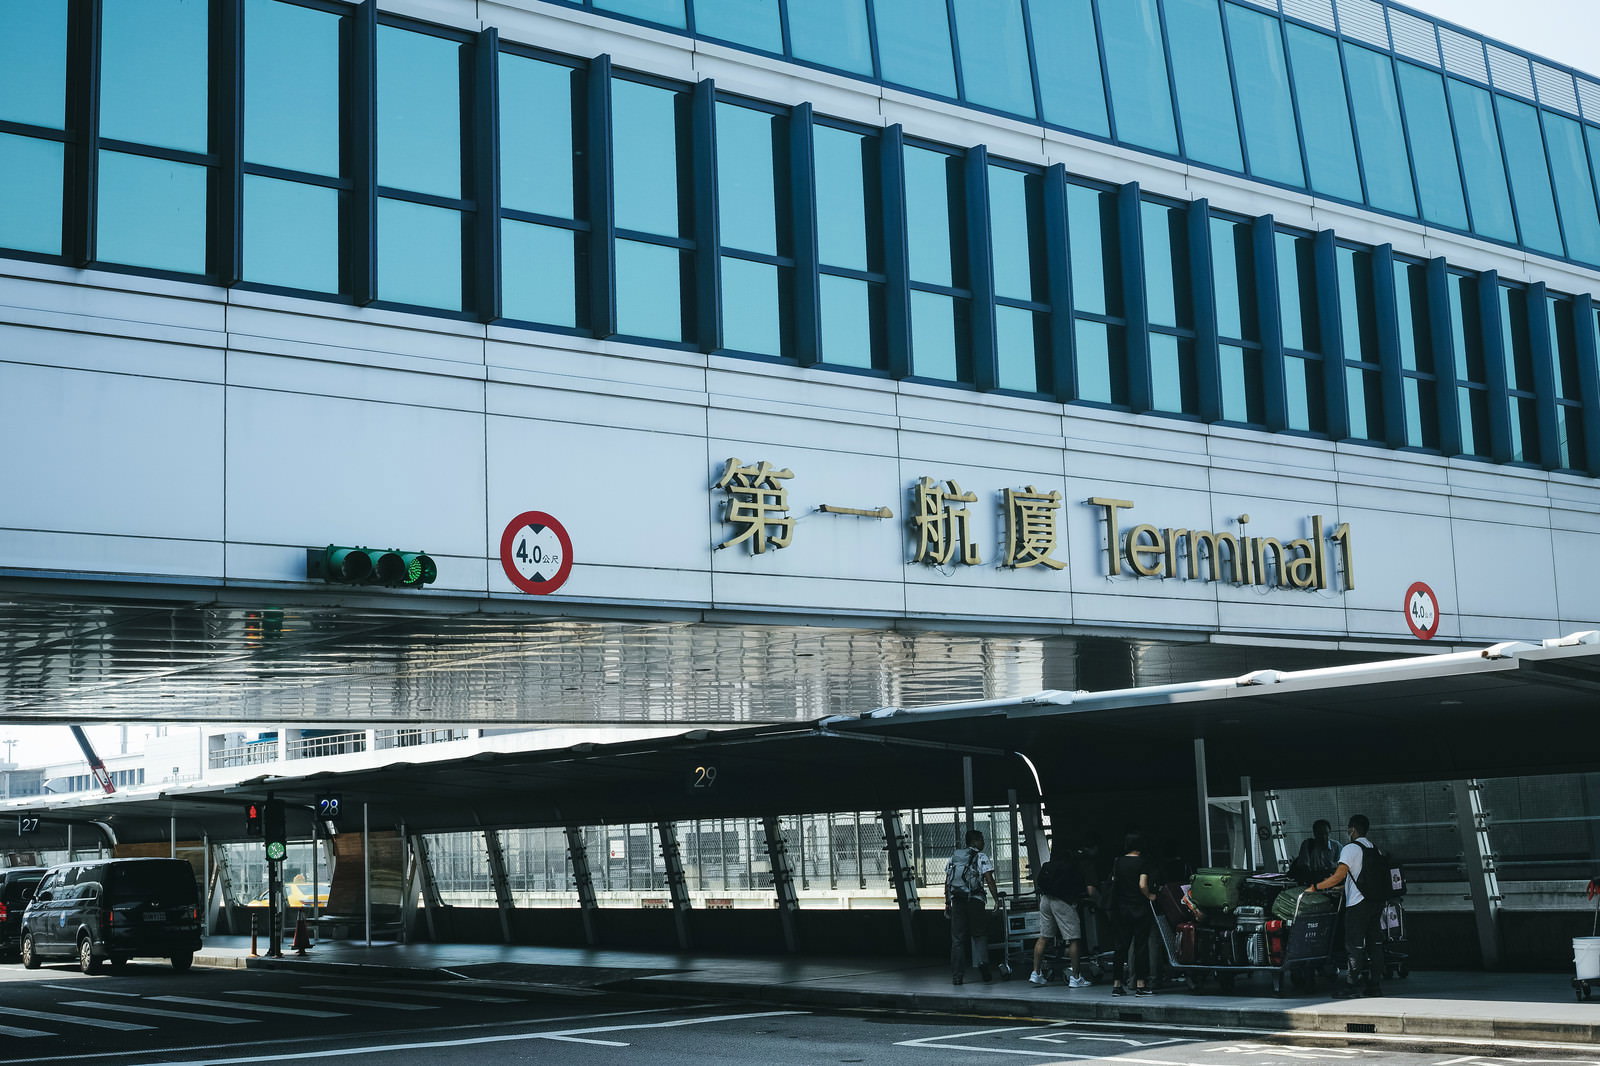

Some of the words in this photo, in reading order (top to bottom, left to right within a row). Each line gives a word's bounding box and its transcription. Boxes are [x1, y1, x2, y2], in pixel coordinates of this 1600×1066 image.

[711, 456, 1068, 571] 第一航廈
[1088, 496, 1327, 590] Terminal
[1330, 522, 1355, 591] 1
[1412, 600, 1433, 619] 4.0
[694, 766, 717, 788] 29
[320, 799, 338, 816] 28
[22, 818, 39, 831] 27
